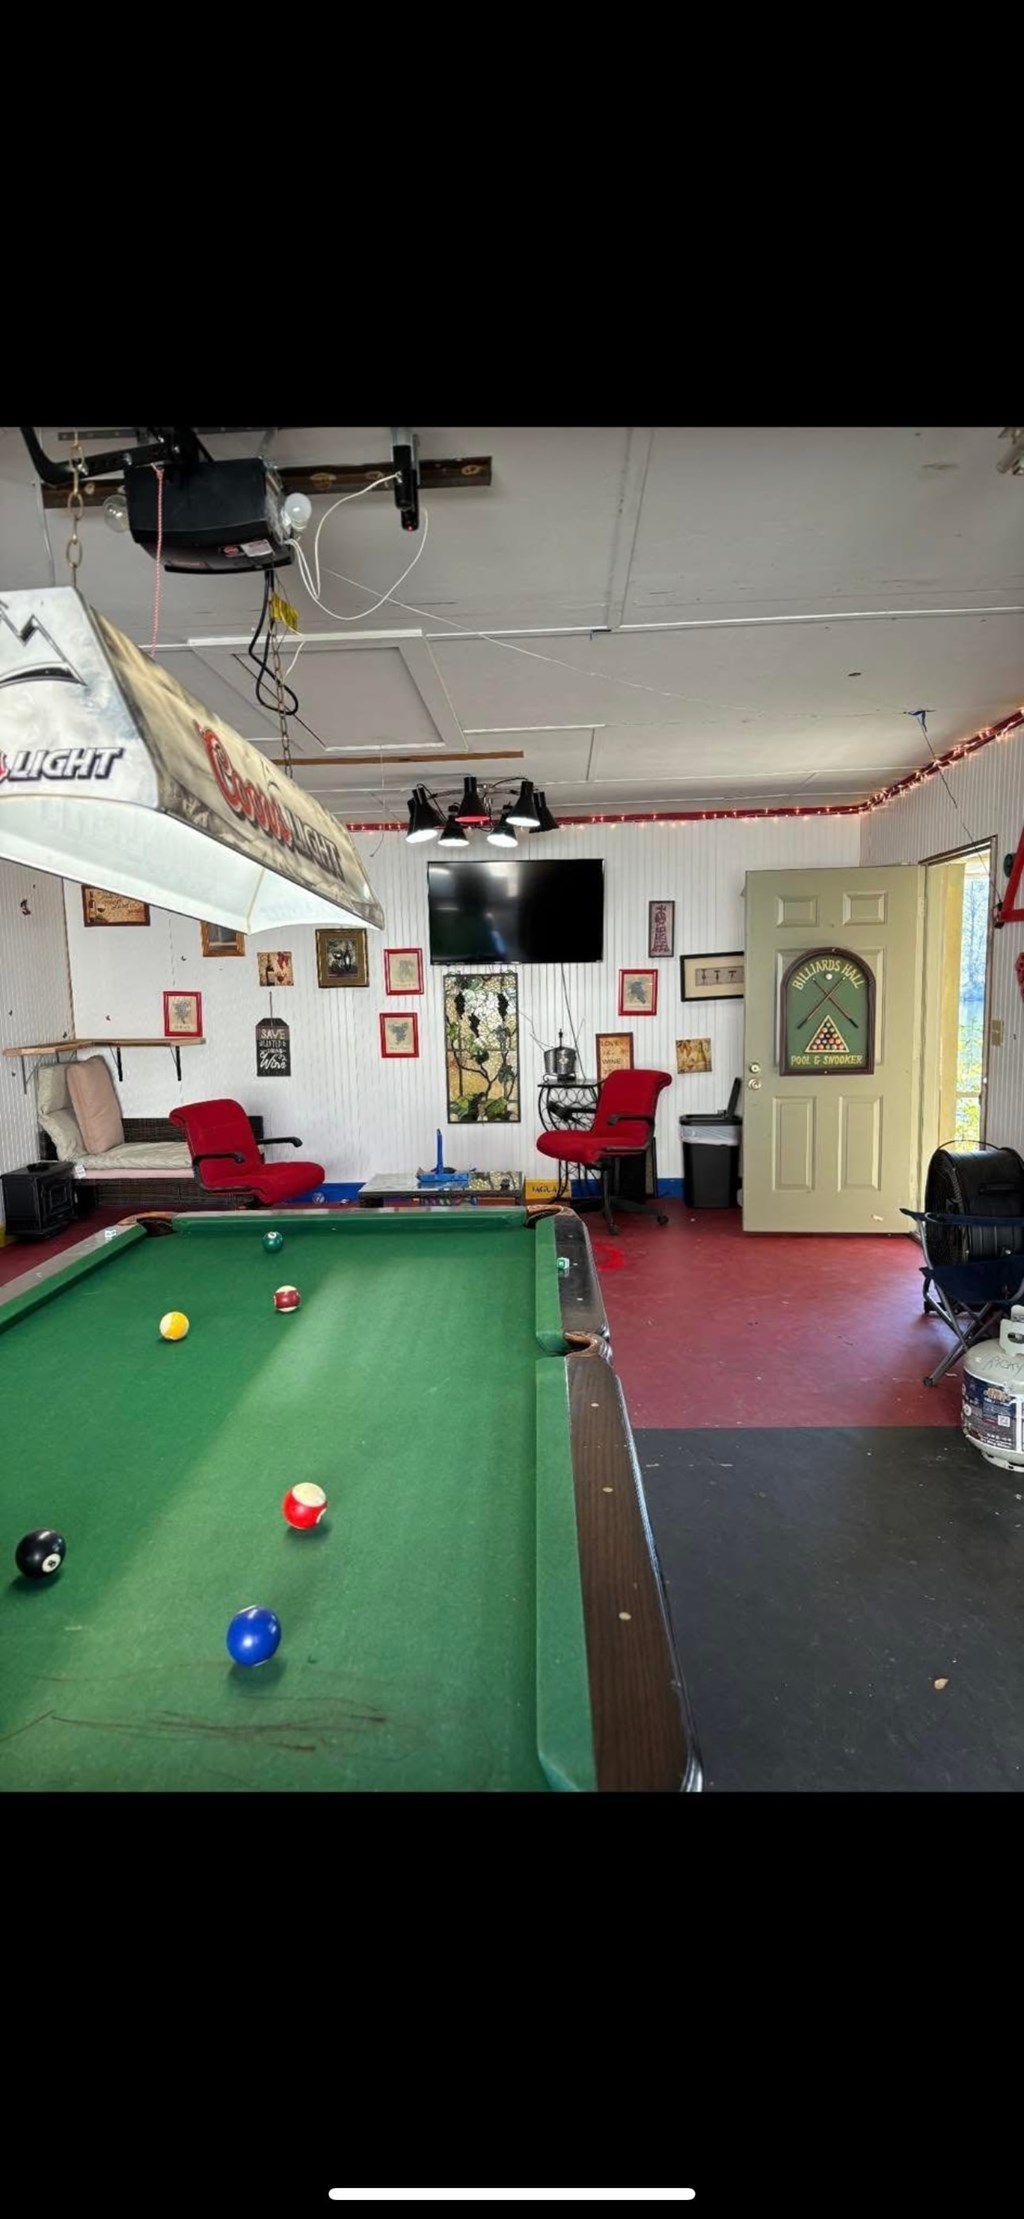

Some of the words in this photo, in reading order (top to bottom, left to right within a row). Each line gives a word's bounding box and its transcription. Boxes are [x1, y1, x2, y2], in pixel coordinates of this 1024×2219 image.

[8, 747, 125, 782] LIGHT
[193, 719, 296, 853] Coors
[284, 806, 346, 883] LIGHT
[791, 960, 841, 990] BILLIARDS
[842, 963, 865, 989] HALL
[260, 1028, 286, 1040] SAVE
[791, 1056, 810, 1066] POOL
[814, 1055, 821, 1065] &
[823, 1056, 863, 1065] SNOOKER
